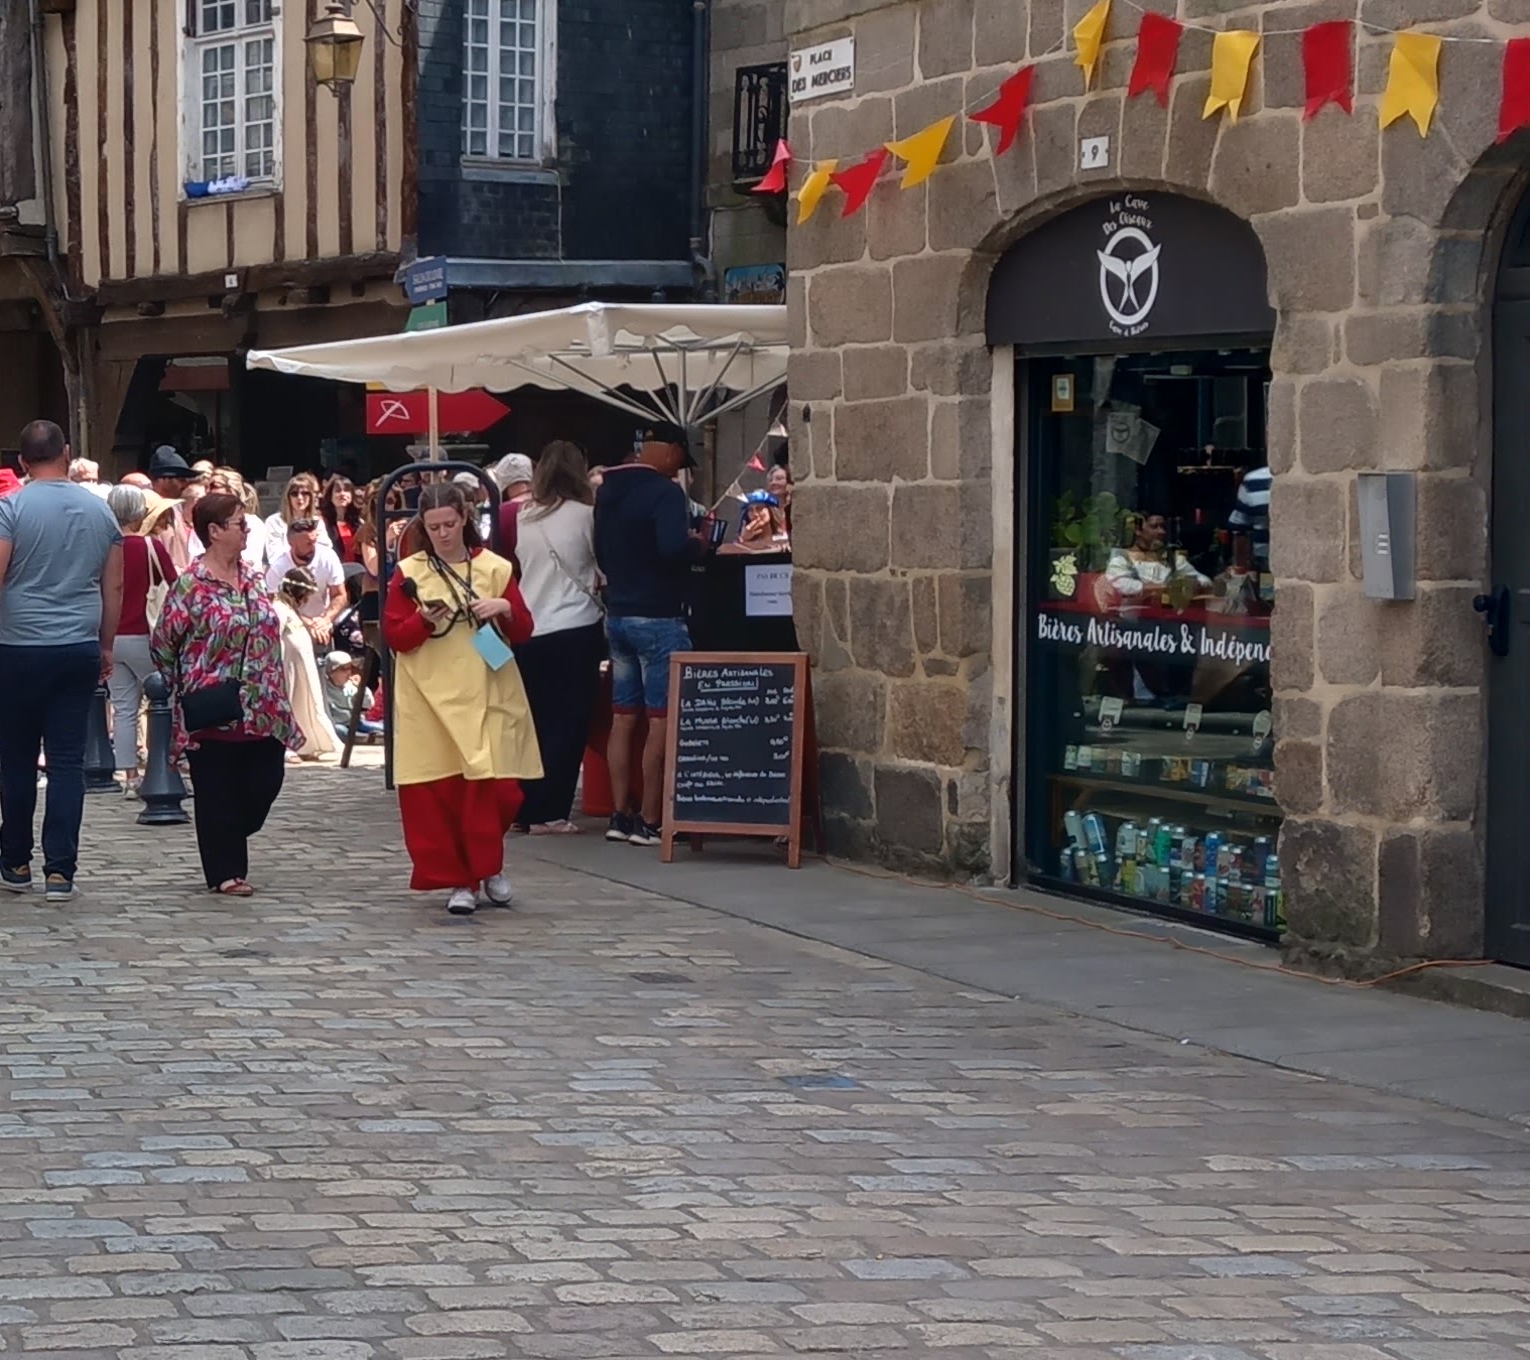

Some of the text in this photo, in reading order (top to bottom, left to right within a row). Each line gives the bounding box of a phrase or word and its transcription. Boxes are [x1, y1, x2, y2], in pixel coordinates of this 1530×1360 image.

[810, 50, 832, 65] PLACE
[792, 65, 851, 93] DES MERCIERS
[1091, 145, 1099, 161] 9
[1038, 614, 1083, 643] Bières
[1087, 618, 1177, 653] Artisanales
[1180, 624, 1196, 654] &
